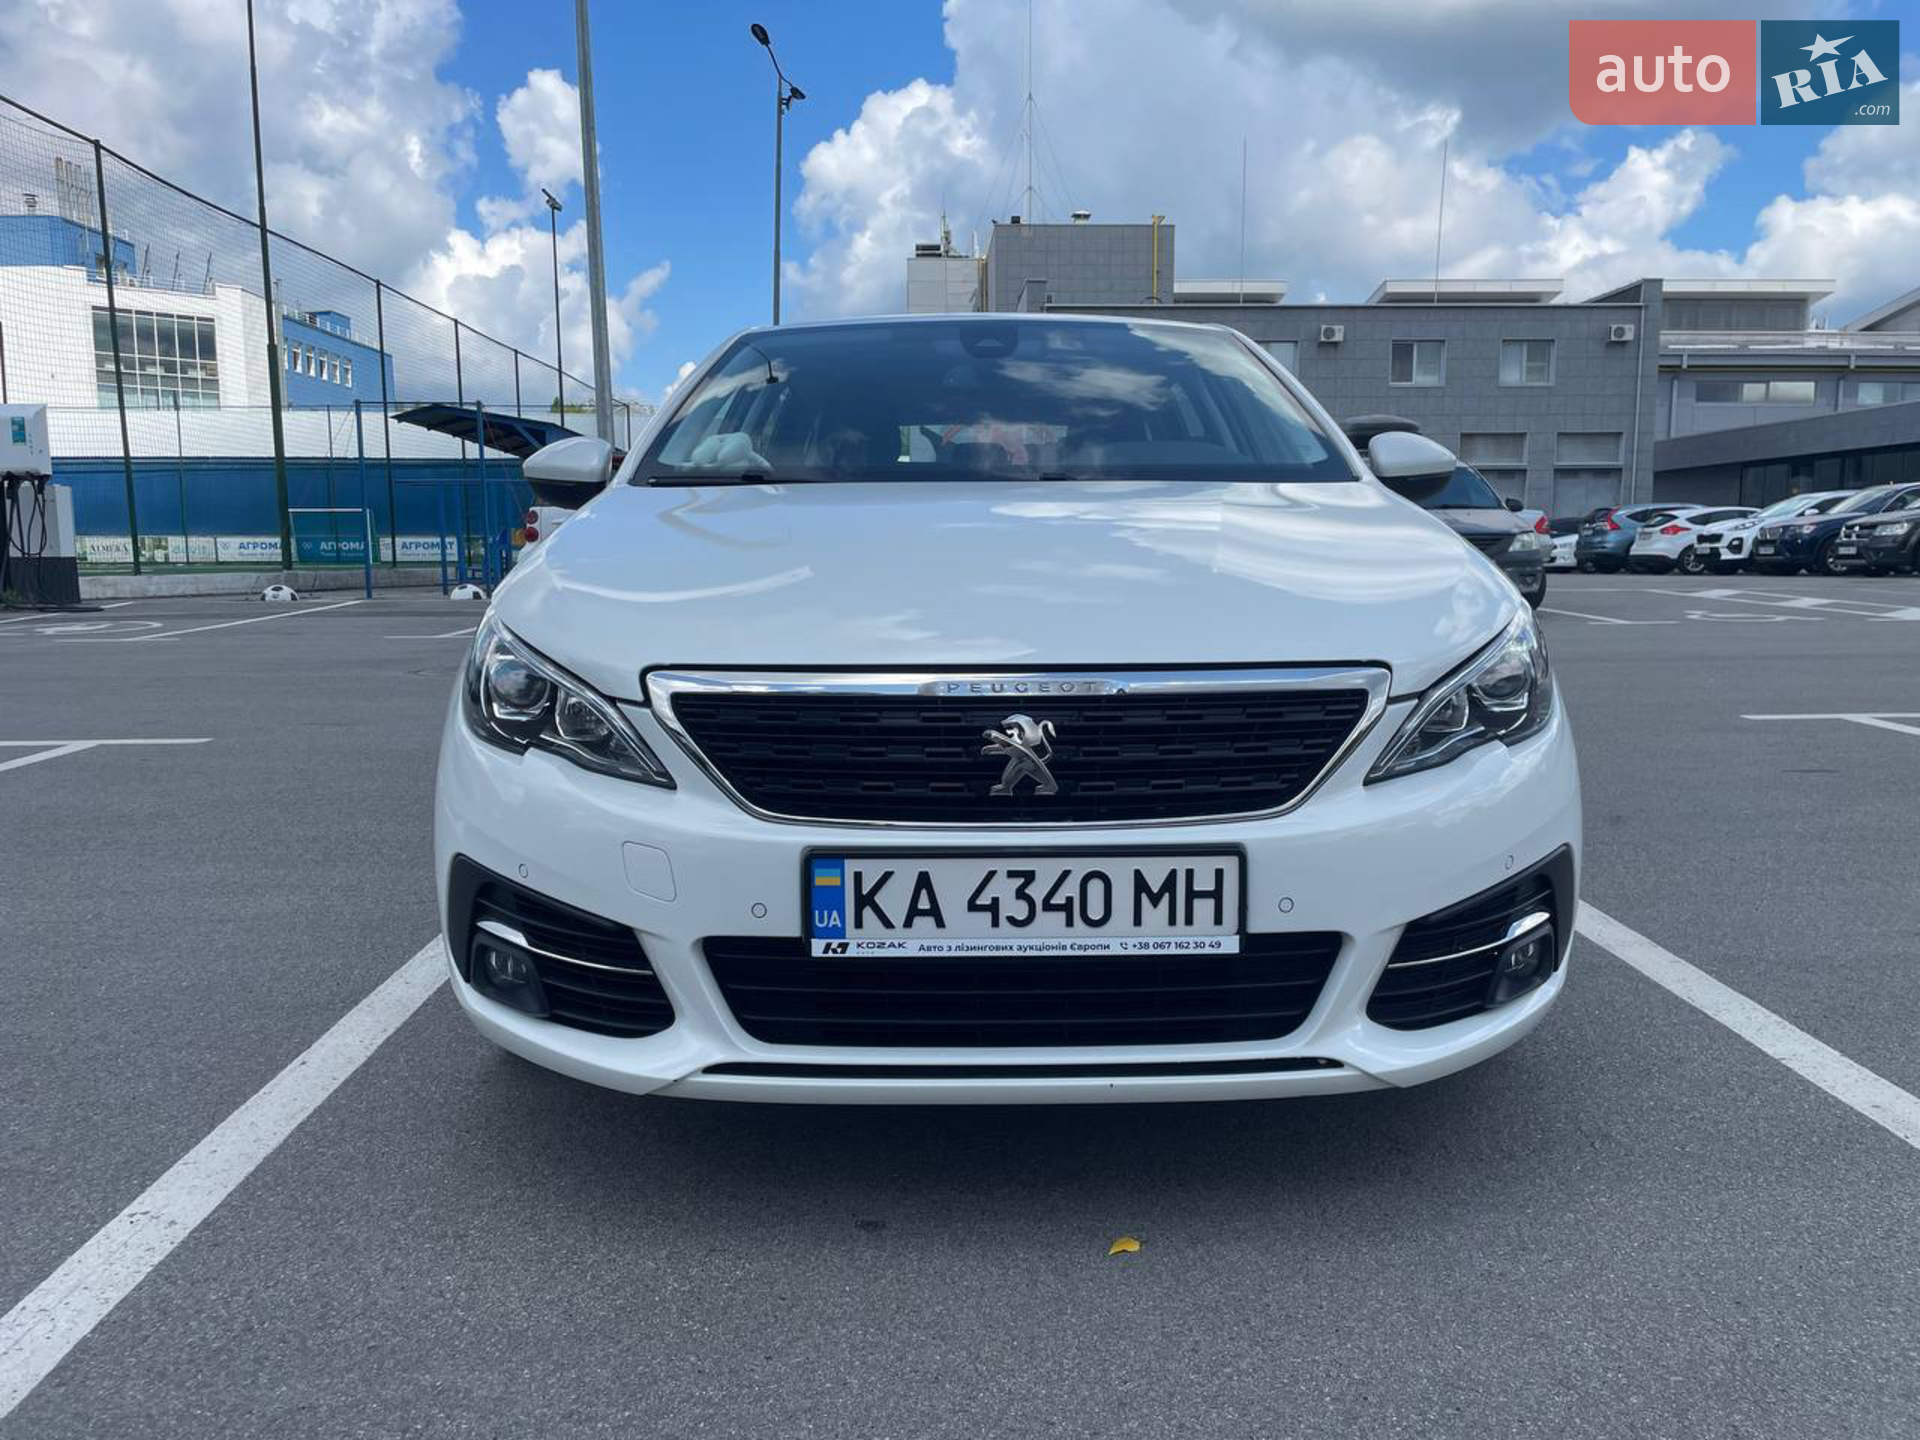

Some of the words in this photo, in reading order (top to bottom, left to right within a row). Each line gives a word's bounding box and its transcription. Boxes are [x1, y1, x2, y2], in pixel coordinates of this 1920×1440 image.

[239, 542, 281, 550] АГРОМ
[320, 541, 364, 550] АГРОМ
[401, 541, 455, 550] АГРОМТ
[947, 682, 1096, 694] PEUGEOT
[853, 869, 946, 930] KA
[966, 868, 1113, 928] 4340
[1132, 867, 1224, 927] MH
[814, 910, 842, 928] UA
[856, 941, 907, 949] KOZAK
[917, 943, 945, 952] Авто
[954, 942, 1014, 952] лізингових
[1016, 941, 1068, 953] аукціонів
[1070, 941, 1111, 953] Європи
[1131, 941, 1150, 950] +38
[1152, 941, 1171, 950] 067
[1174, 941, 1191, 949] 162
[1192, 940, 1206, 949] 30
[1208, 940, 1222, 949] 49
